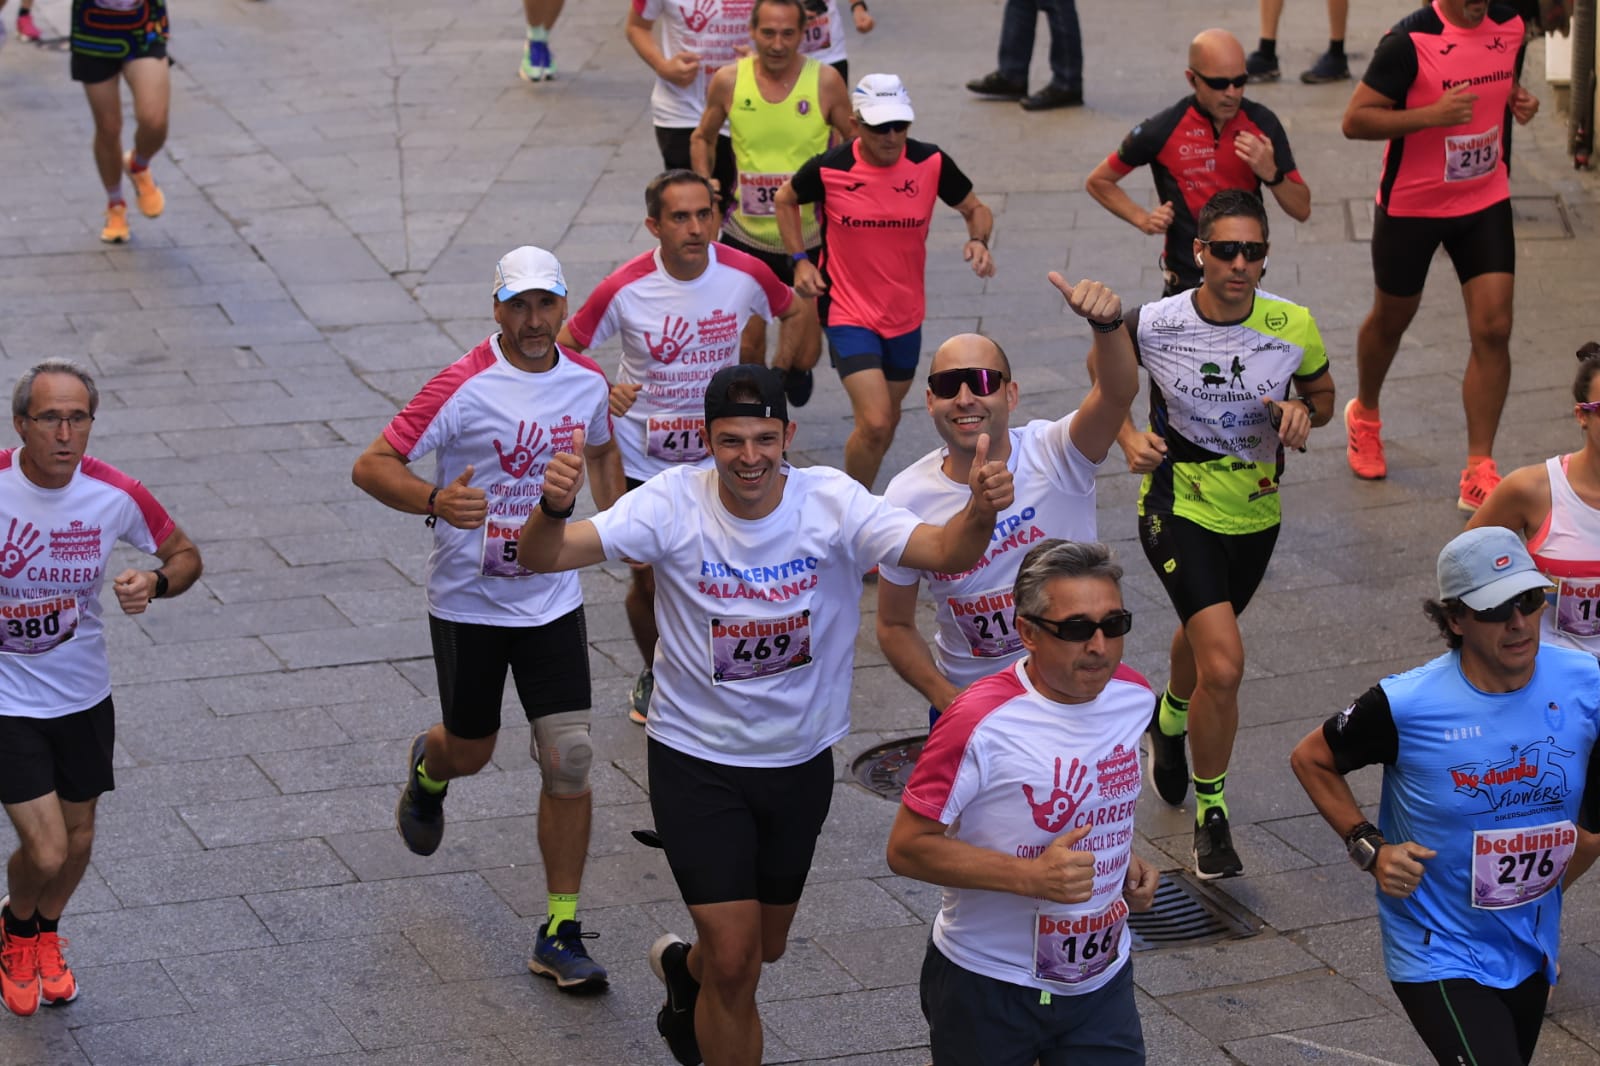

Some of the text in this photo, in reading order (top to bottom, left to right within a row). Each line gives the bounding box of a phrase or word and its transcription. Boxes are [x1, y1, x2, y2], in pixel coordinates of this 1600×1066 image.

[1460, 146, 1492, 168] 213
[667, 387, 690, 399] MAYOR
[691, 387, 700, 398] DE
[1174, 378, 1280, 403] La Corralina, S.L.
[1190, 415, 1217, 425] AMTEL
[487, 502, 507, 516] LAZA
[27, 566, 100, 583] CARRERA
[700, 556, 819, 583] FISIOCENTRO
[11, 587, 20, 598] LA
[698, 574, 818, 602] SALAMANCA
[0, 597, 75, 618] edunia
[7, 611, 60, 638] 380
[712, 615, 809, 638] bedunia
[973, 611, 1018, 639] 21
[733, 634, 791, 662] 469
[1500, 786, 1561, 808] FLOWERS
[1476, 827, 1575, 855] bedunia
[1498, 849, 1554, 885] 276
[1039, 900, 1128, 935] bedunia
[1062, 927, 1113, 963] 166
